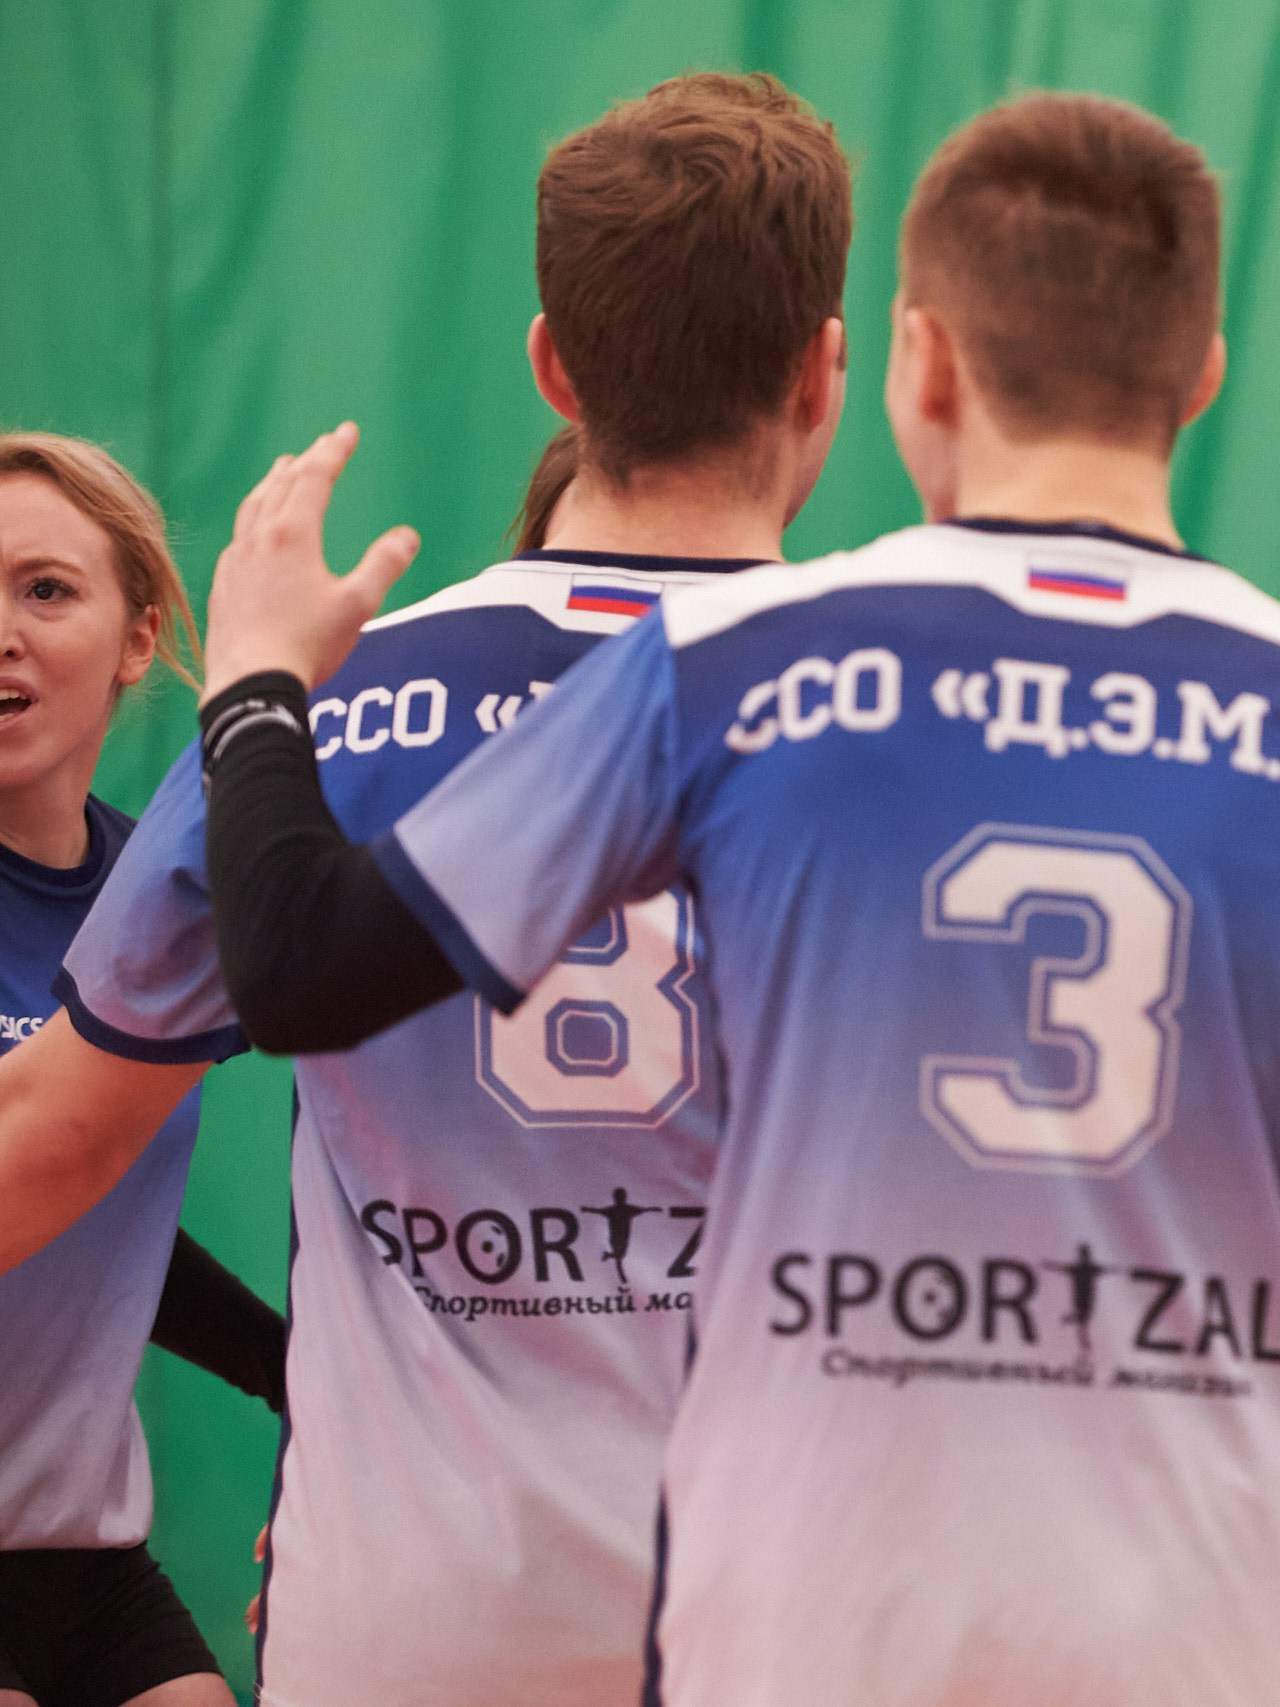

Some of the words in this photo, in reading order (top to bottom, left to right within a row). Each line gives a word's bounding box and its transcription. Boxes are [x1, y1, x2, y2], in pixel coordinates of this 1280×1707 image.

[308, 678, 447, 760] ССО
[724, 648, 902, 754] ССО
[474, 886, 700, 1129] 8
[921, 823, 1193, 1178] 3
